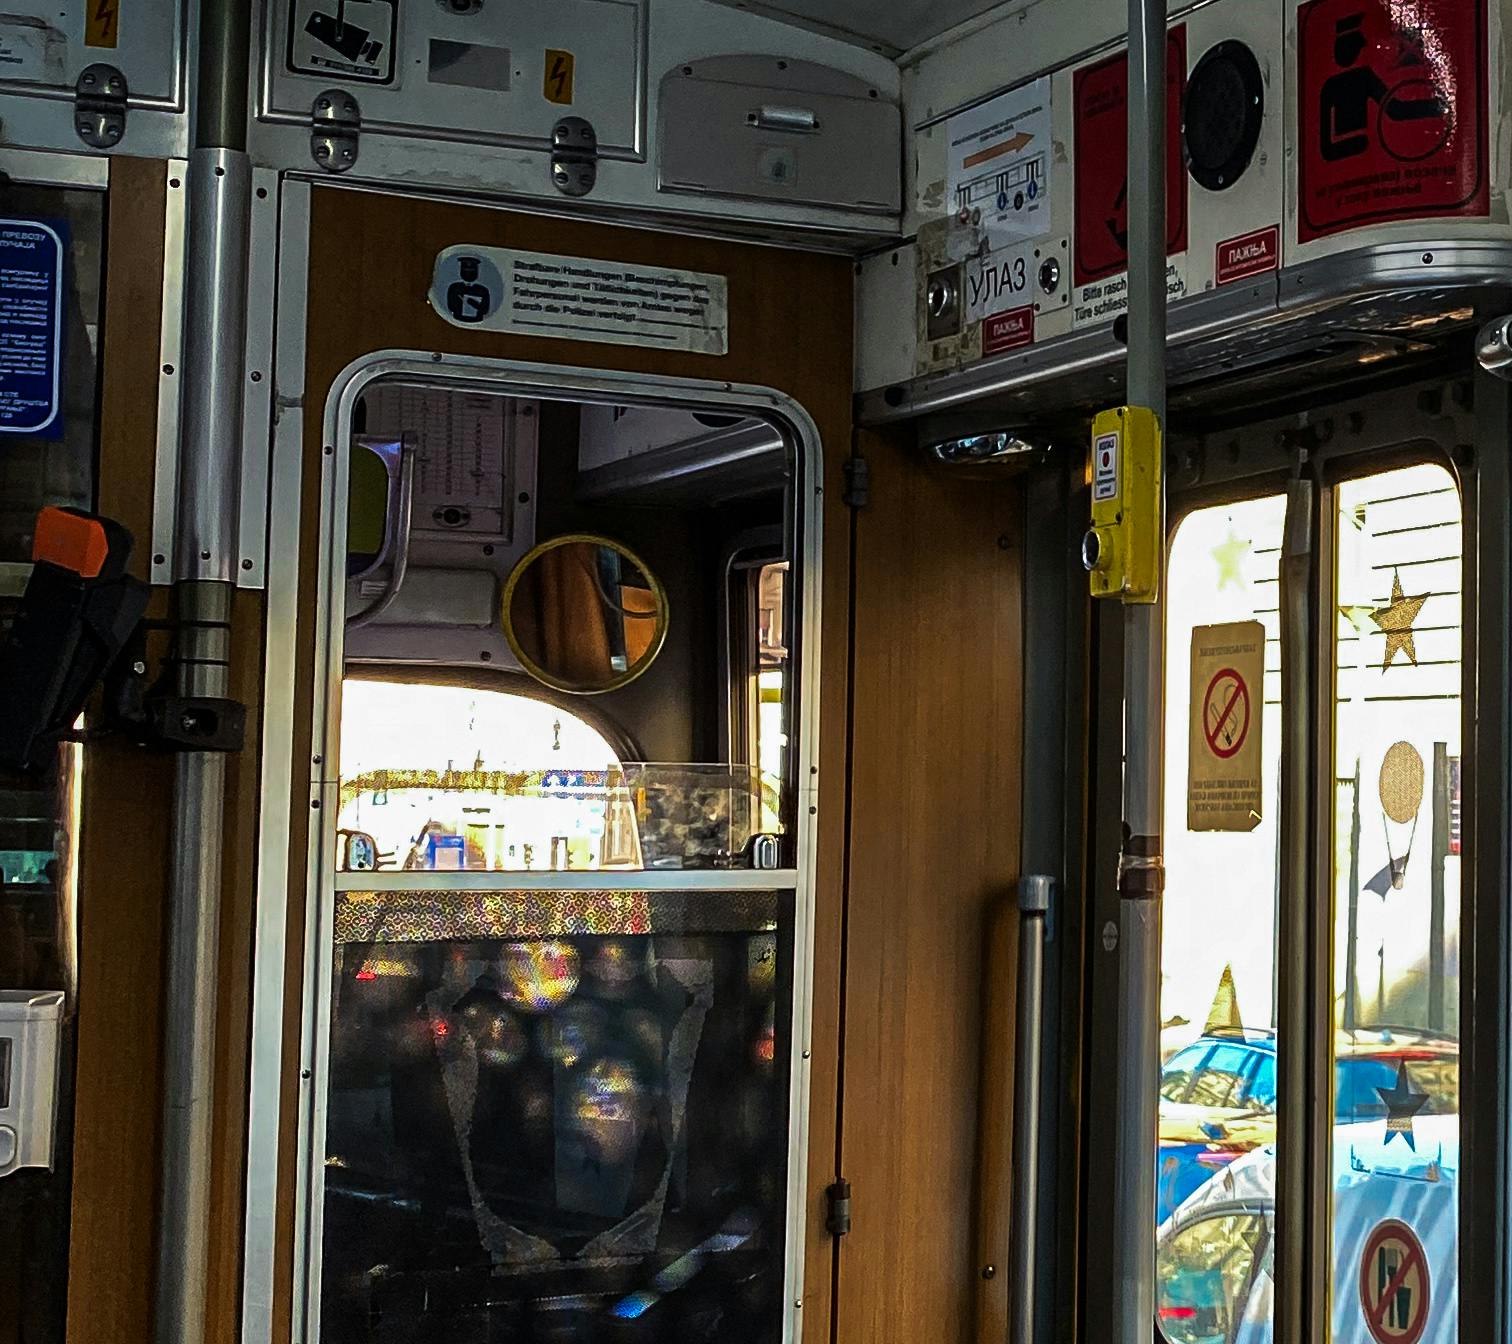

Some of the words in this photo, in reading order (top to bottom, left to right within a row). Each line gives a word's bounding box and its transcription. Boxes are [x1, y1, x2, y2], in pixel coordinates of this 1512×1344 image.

[1228, 239, 1268, 264] ПАЖЊА
[969, 257, 1027, 306] УЛАЗ
[1082, 286, 1101, 302] Bitte
[1103, 277, 1127, 297] rasch
